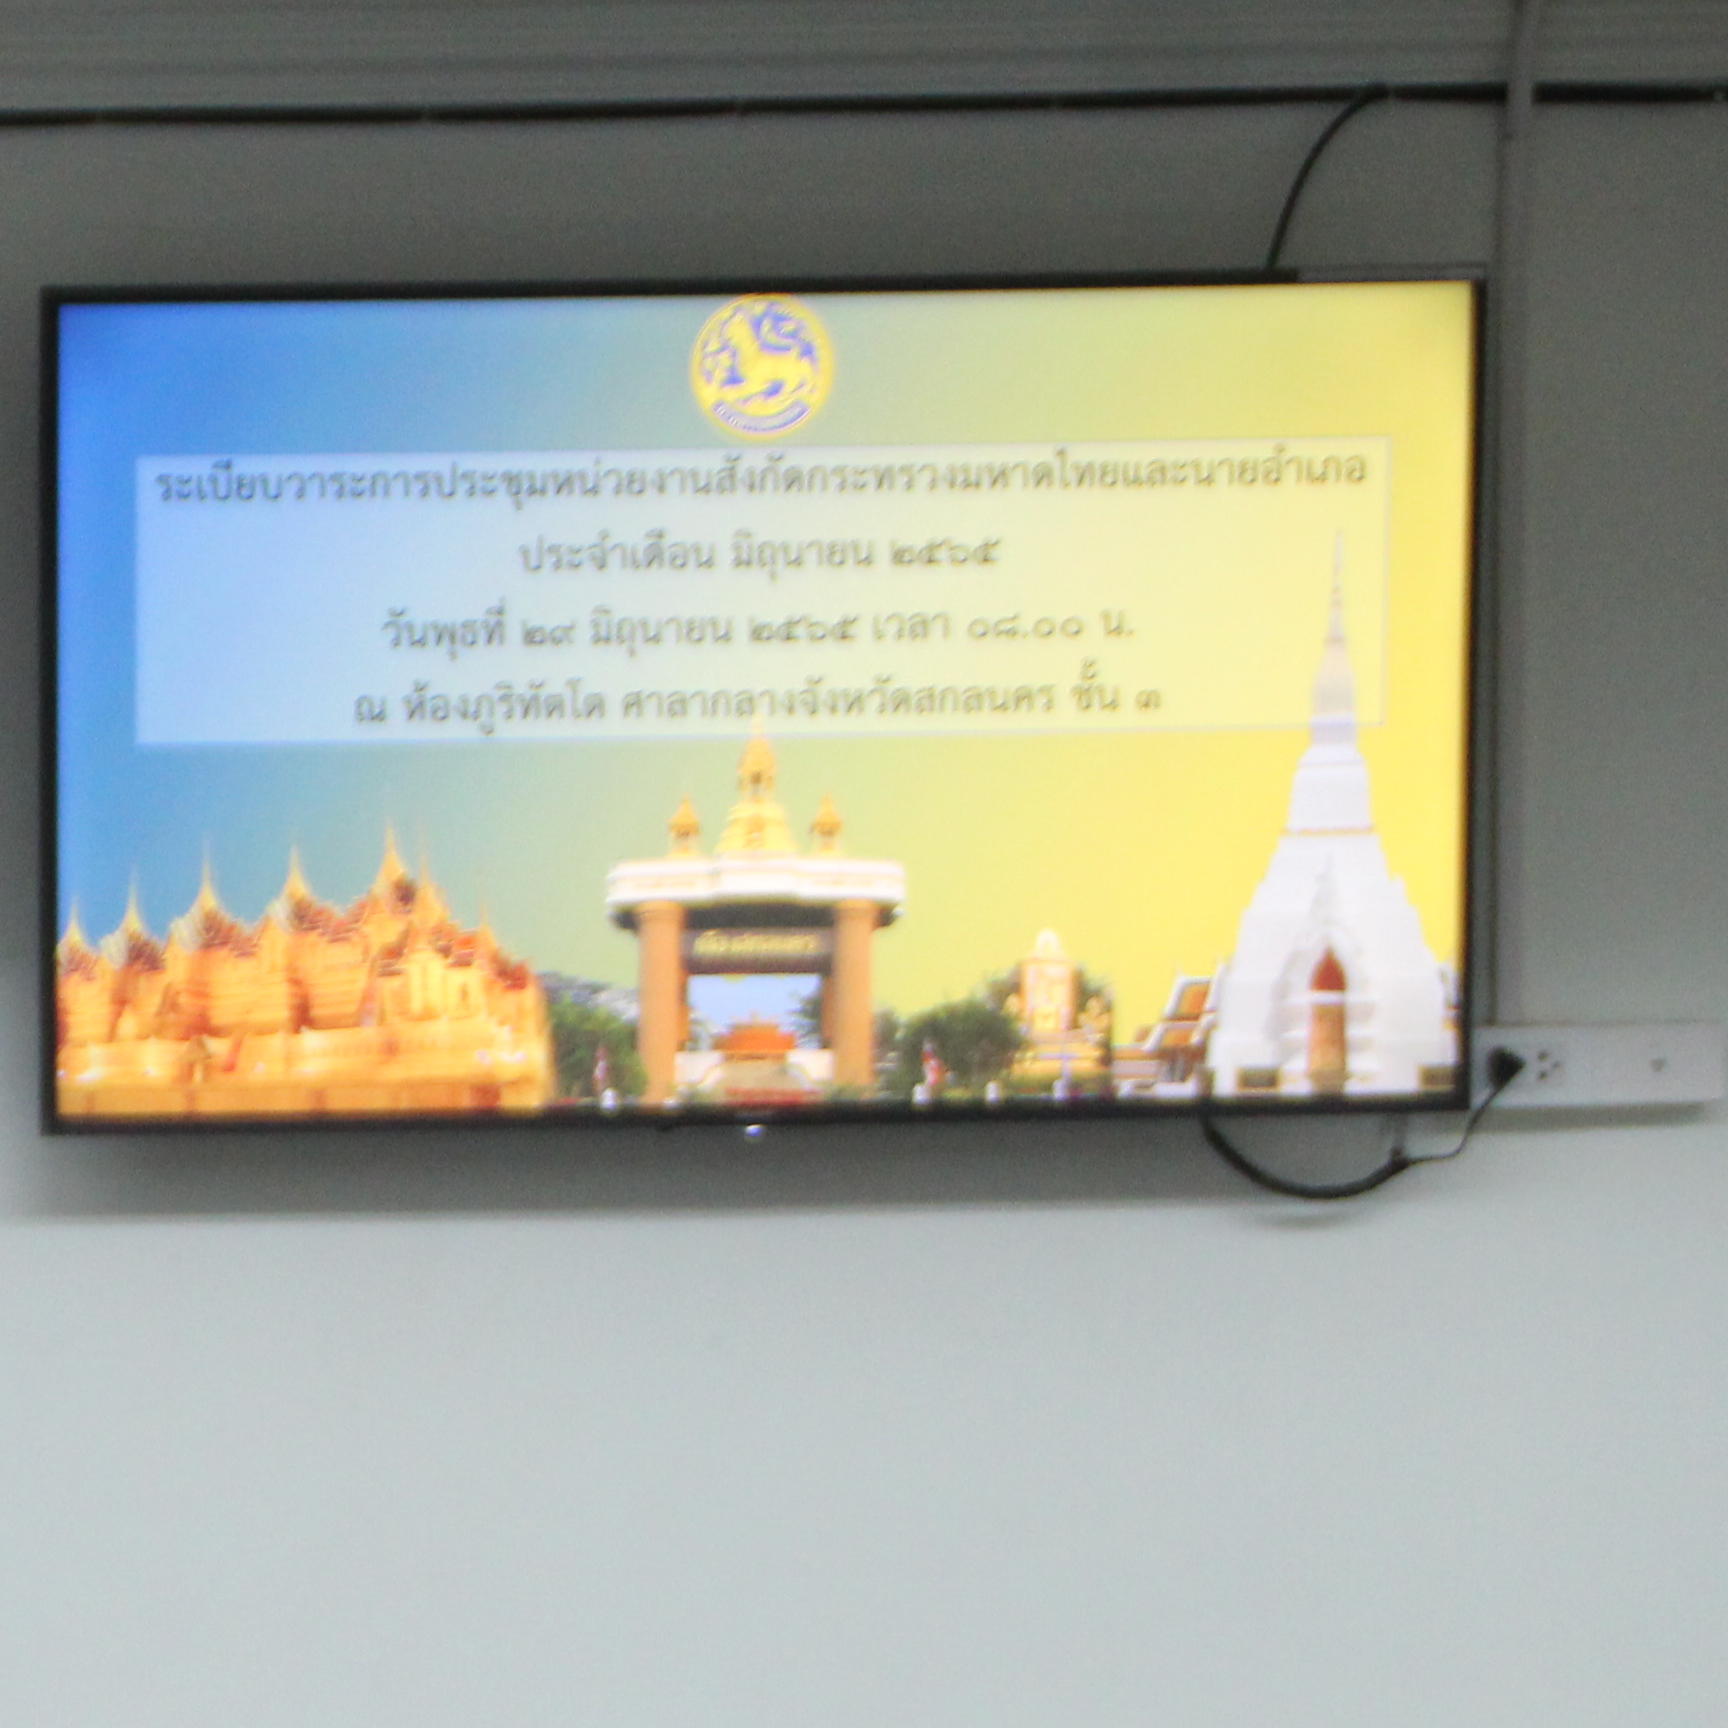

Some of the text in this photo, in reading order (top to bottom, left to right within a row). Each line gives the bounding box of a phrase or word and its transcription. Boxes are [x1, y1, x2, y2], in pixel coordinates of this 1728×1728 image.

[154, 447, 1367, 511] ระเบียบวาระการประชุมหน่วยงานสังกัดกระทรวงมหาดไทยและนายอำเภอ
[519, 528, 1001, 582] ประจำเดือน มิถุนายน ๒๕๖๕
[381, 595, 507, 662] วันพุธที่
[589, 604, 732, 659] มิถุนายน
[748, 610, 859, 645] ๒๕๖๕
[871, 609, 951, 642] เวลา
[1100, 607, 1136, 640] น.
[354, 691, 387, 725] ณ
[623, 675, 1055, 722] ศาลากลางจังหวัดสกลนคร
[1070, 656, 1120, 712] ชั้น
[1136, 686, 1162, 712] ๓
